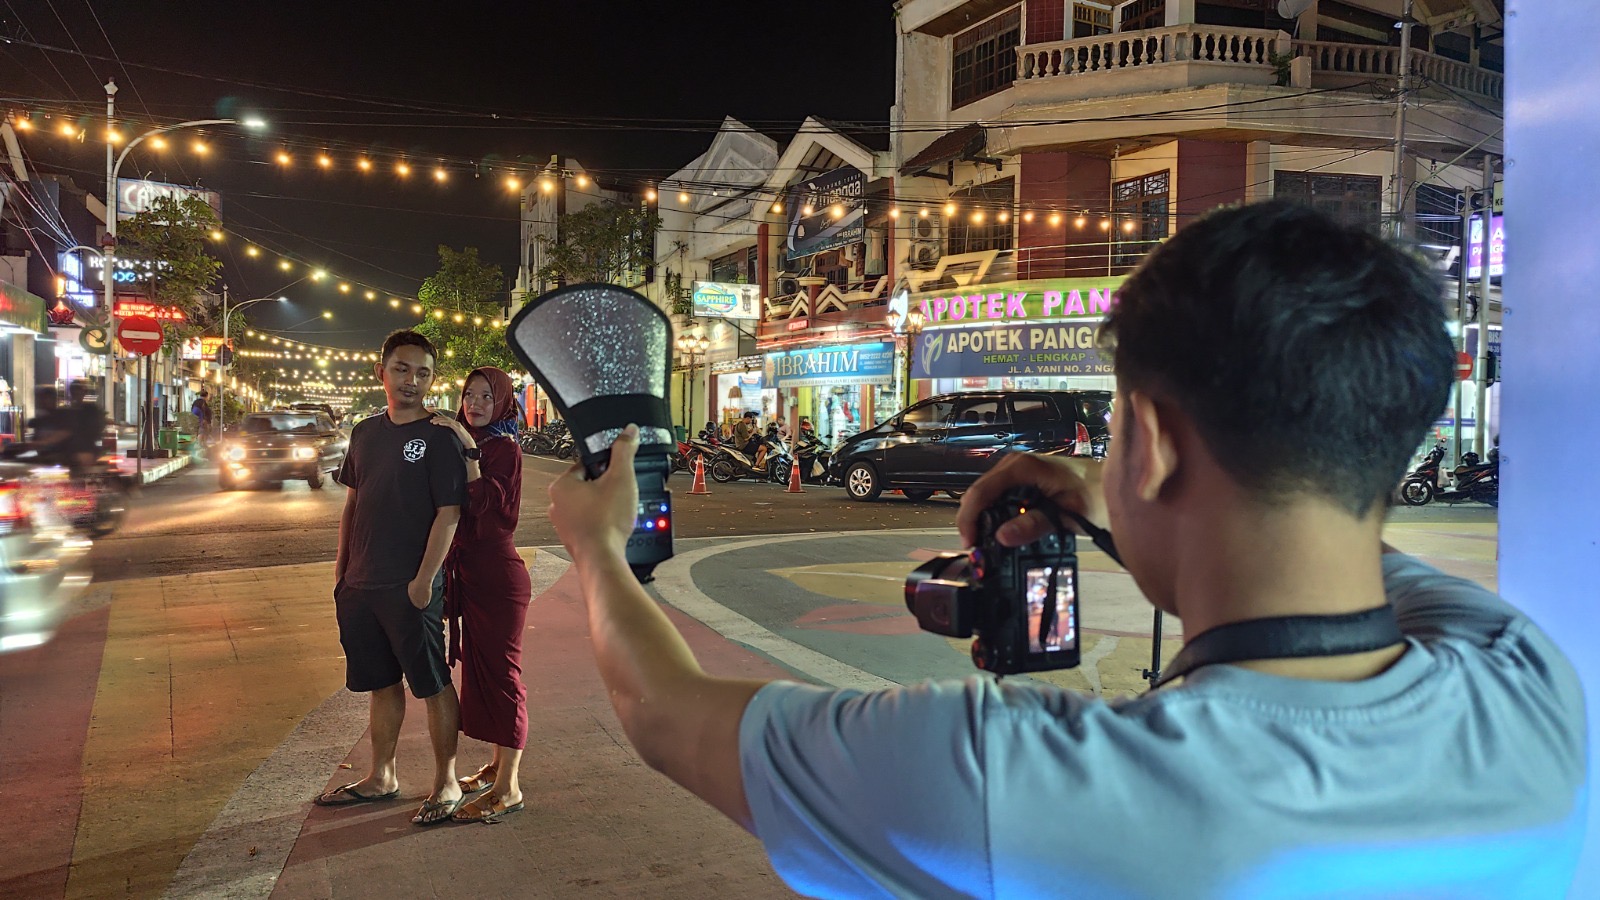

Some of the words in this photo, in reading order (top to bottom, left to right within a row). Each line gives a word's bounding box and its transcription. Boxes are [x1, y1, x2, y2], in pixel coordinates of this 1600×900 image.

[1495, 198, 1504, 206] KE
[696, 293, 735, 305] SAPPHIRE
[920, 292, 1028, 322] APOTEK
[1042, 287, 1119, 317] PAN
[946, 328, 1024, 354] APOTEK
[202, 344, 218, 355] RA
[776, 350, 860, 377] IBRAHIM
[983, 354, 1020, 364] HEMAT
[1030, 352, 1086, 363] LENGKAP
[1008, 366, 1022, 374] JL.
[1024, 366, 1035, 374] A.
[1037, 365, 1061, 373] YANI
[1063, 365, 1082, 373] NO.
[1085, 365, 1092, 373] 2
